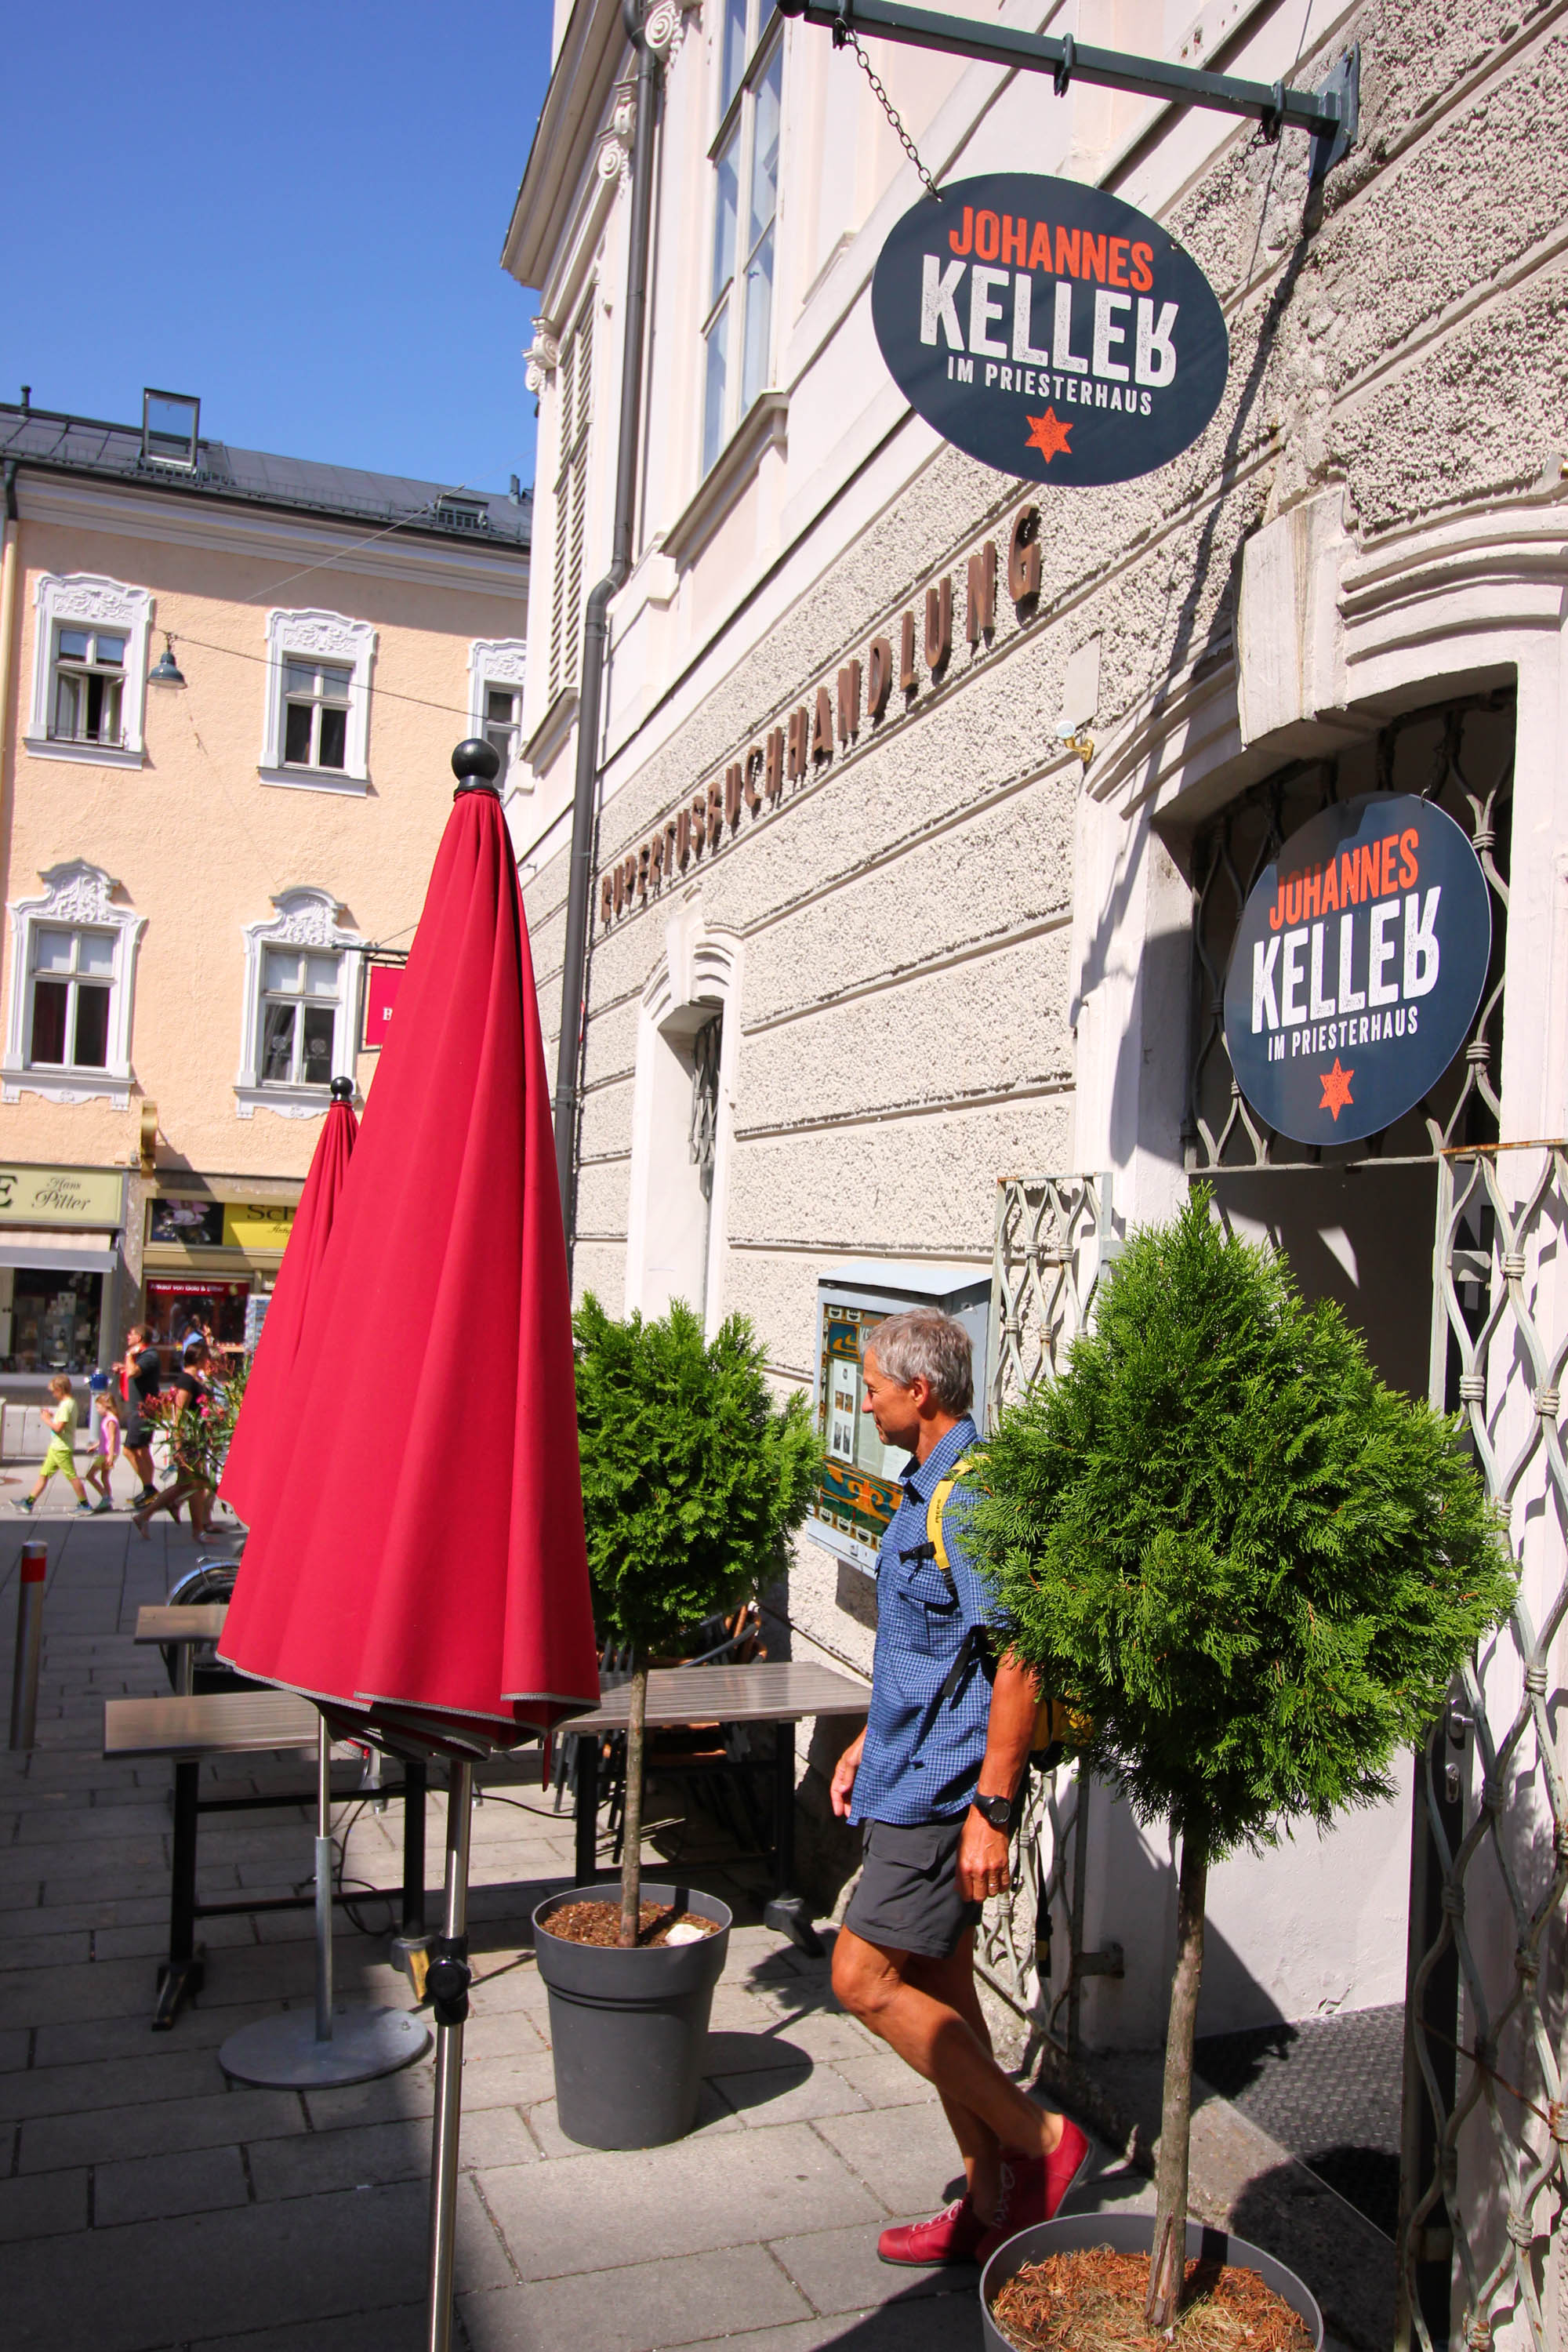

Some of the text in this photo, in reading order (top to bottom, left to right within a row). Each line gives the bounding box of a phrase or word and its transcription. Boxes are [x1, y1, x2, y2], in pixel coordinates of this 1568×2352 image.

[949, 205, 1154, 292] JOHANNES
[920, 254, 1179, 388] KELLER
[947, 356, 1152, 416] IM PRIESTERHAUS
[601, 504, 1042, 922] RUPERTUSBUCHHANDLUNG
[1269, 827, 1420, 931] JOHANNES
[1251, 886, 1442, 1034] KELLER
[1267, 1006, 1419, 1062] IM PRIESTERHAUS
